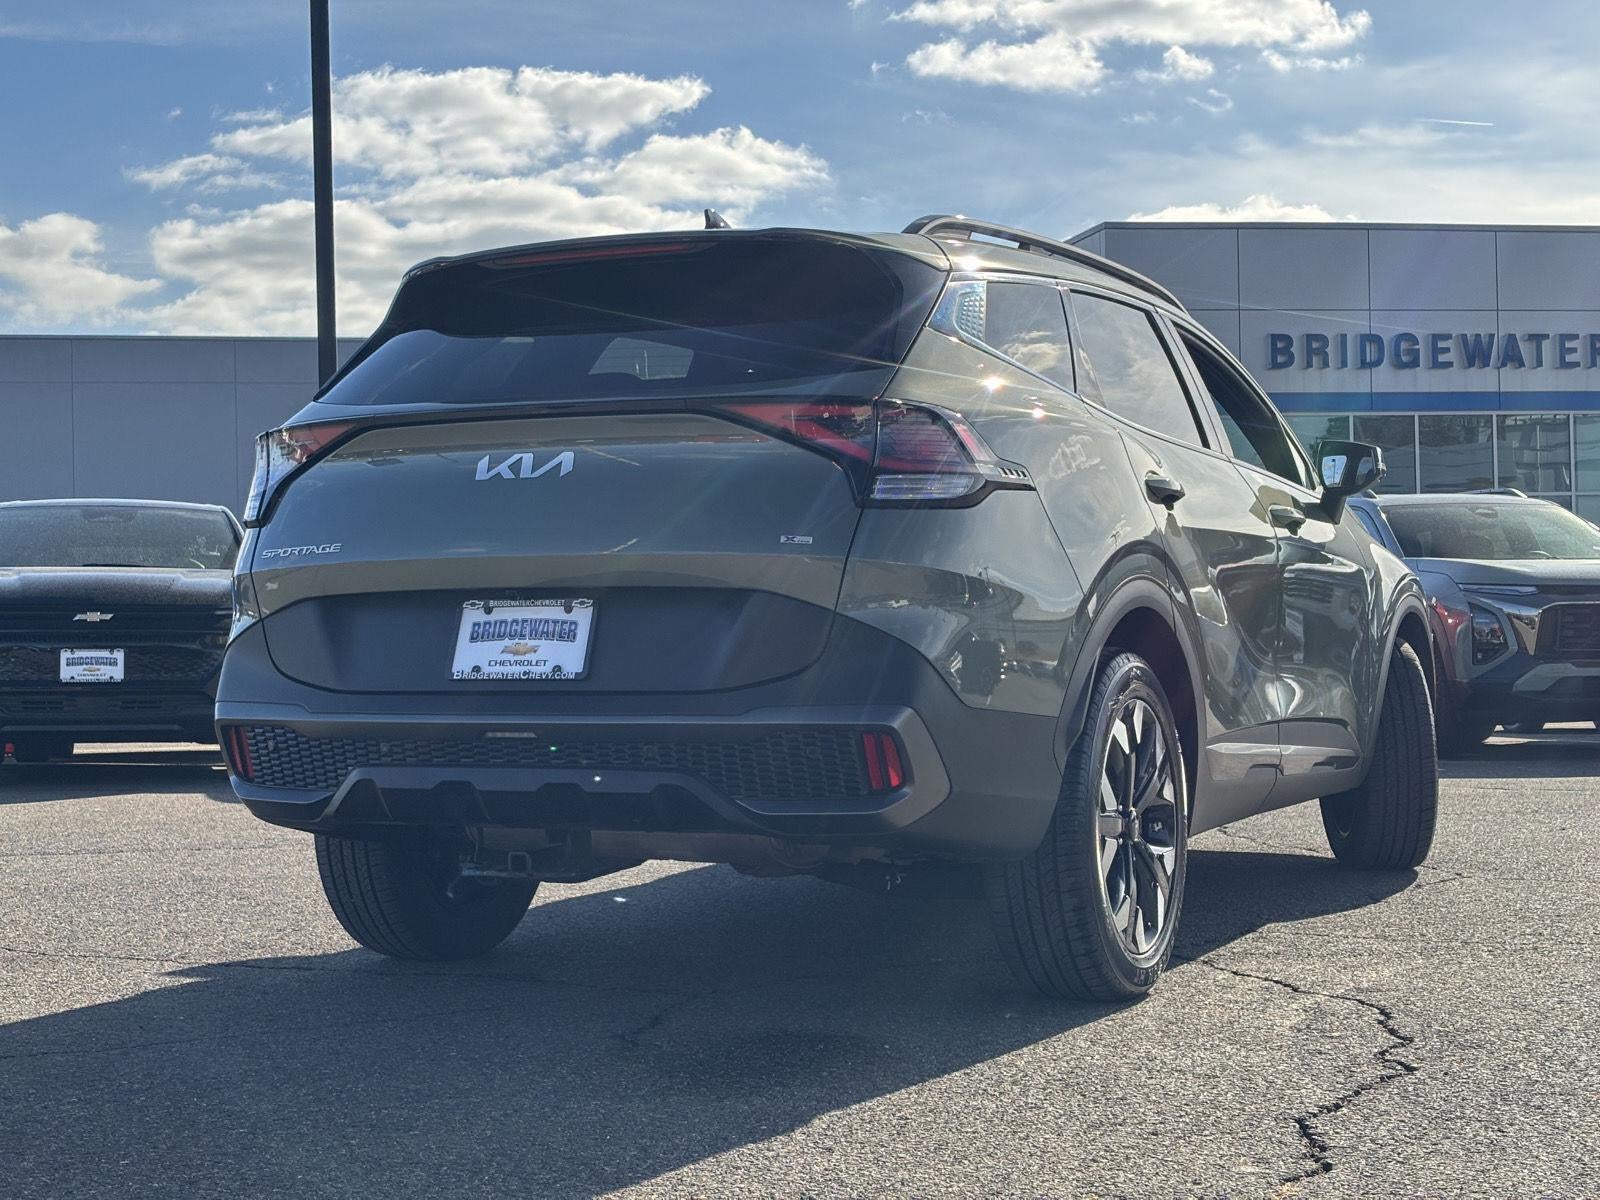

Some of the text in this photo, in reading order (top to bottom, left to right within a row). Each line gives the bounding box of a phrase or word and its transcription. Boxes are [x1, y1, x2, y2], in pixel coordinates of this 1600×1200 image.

[475, 452, 575, 480] KIA
[262, 543, 342, 559] SPORTAGE
[469, 618, 578, 643] BRIDGEWATER
[66, 656, 118, 667] BRIDGEWATER
[488, 659, 548, 667] CHEVROLET
